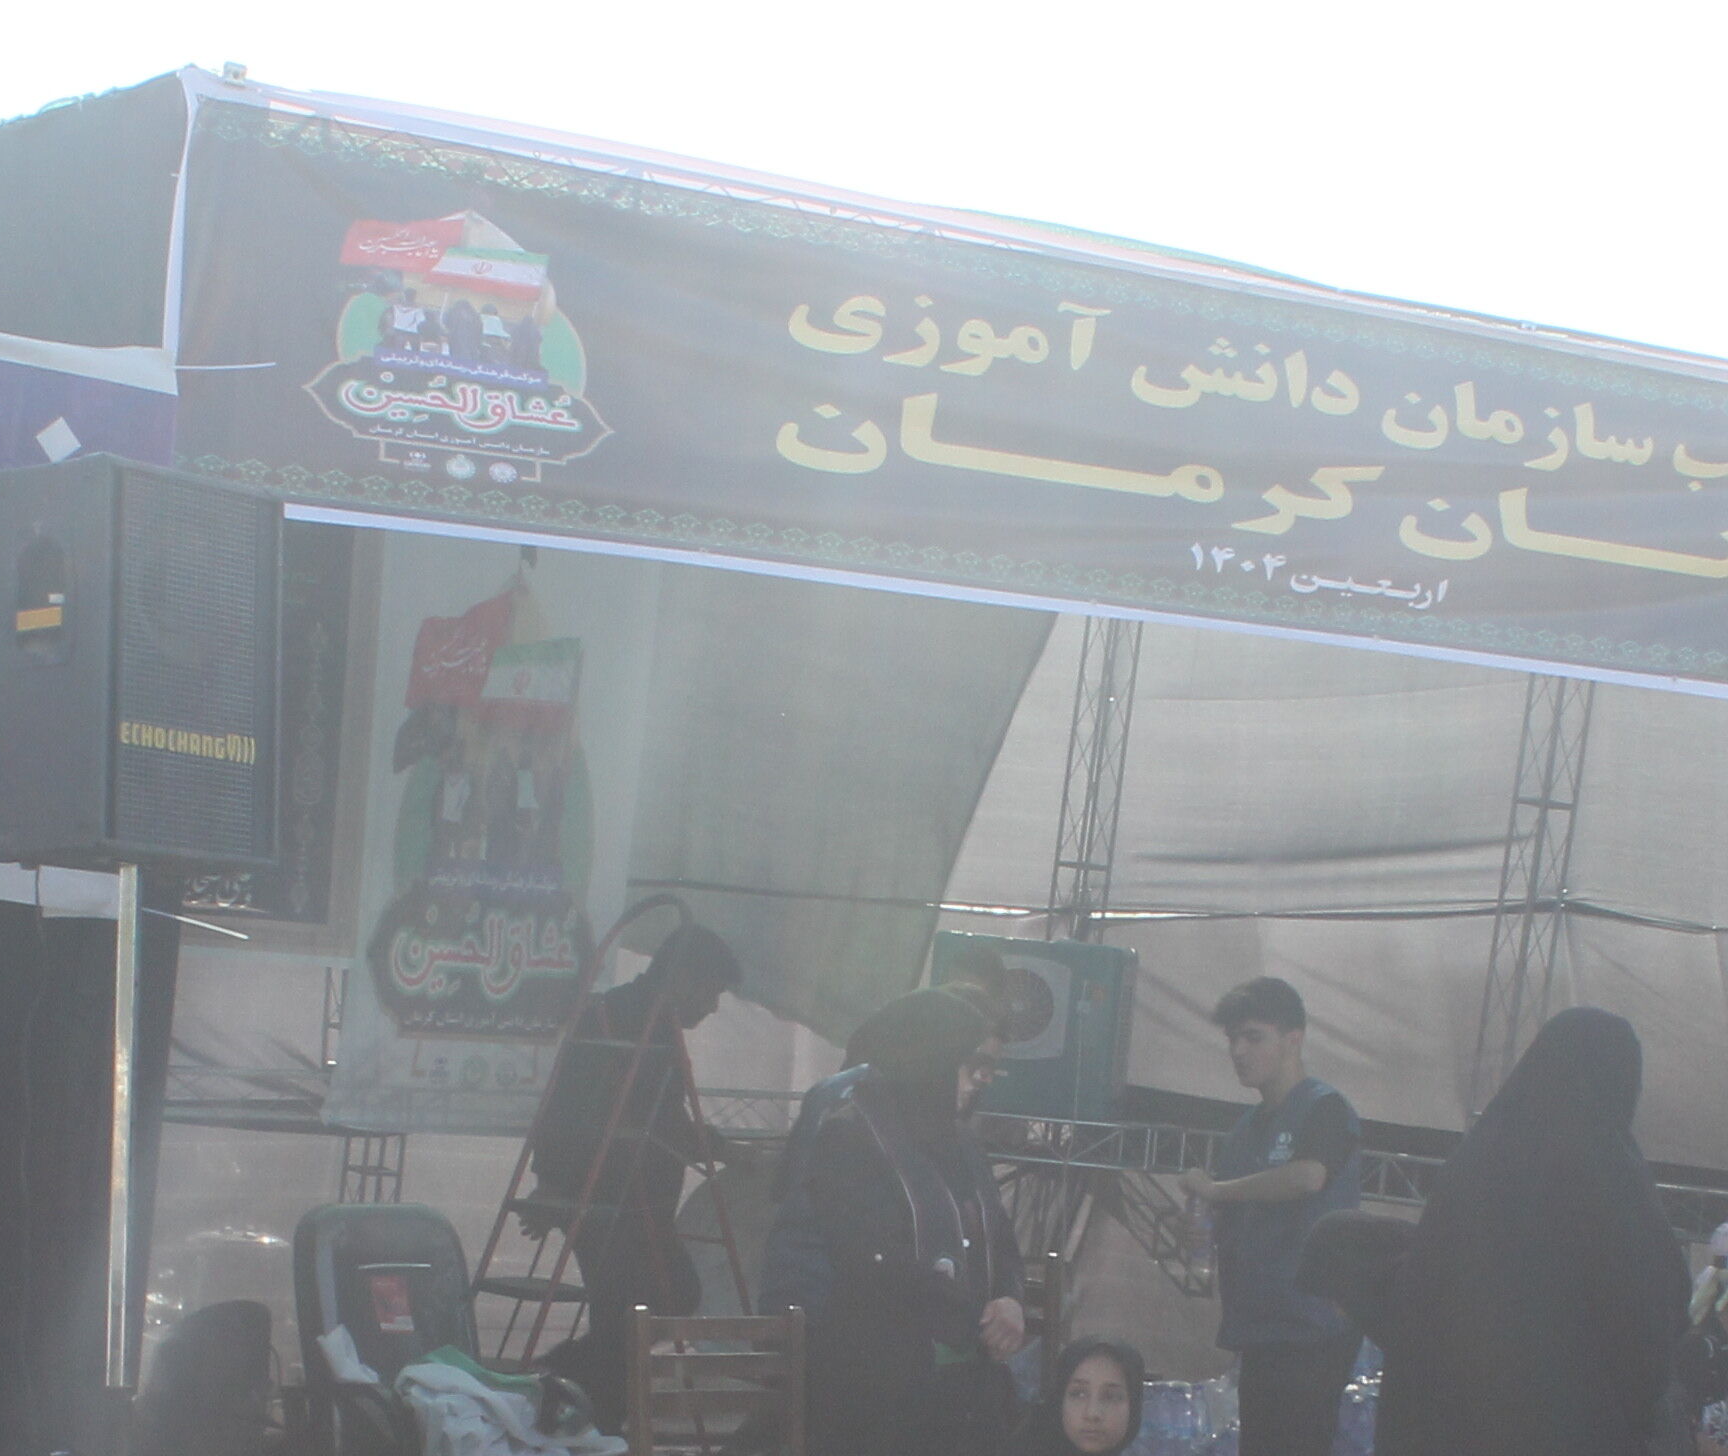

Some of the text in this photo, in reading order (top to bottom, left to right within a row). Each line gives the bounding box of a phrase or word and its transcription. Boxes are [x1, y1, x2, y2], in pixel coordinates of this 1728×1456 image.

[788, 296, 1112, 376] آموزی
[1131, 337, 1360, 415] دانش
[776, 392, 1385, 535] کرمان
[1381, 381, 1654, 471] سازمان
[1190, 541, 1449, 610] اربعین ۱۴۰۴
